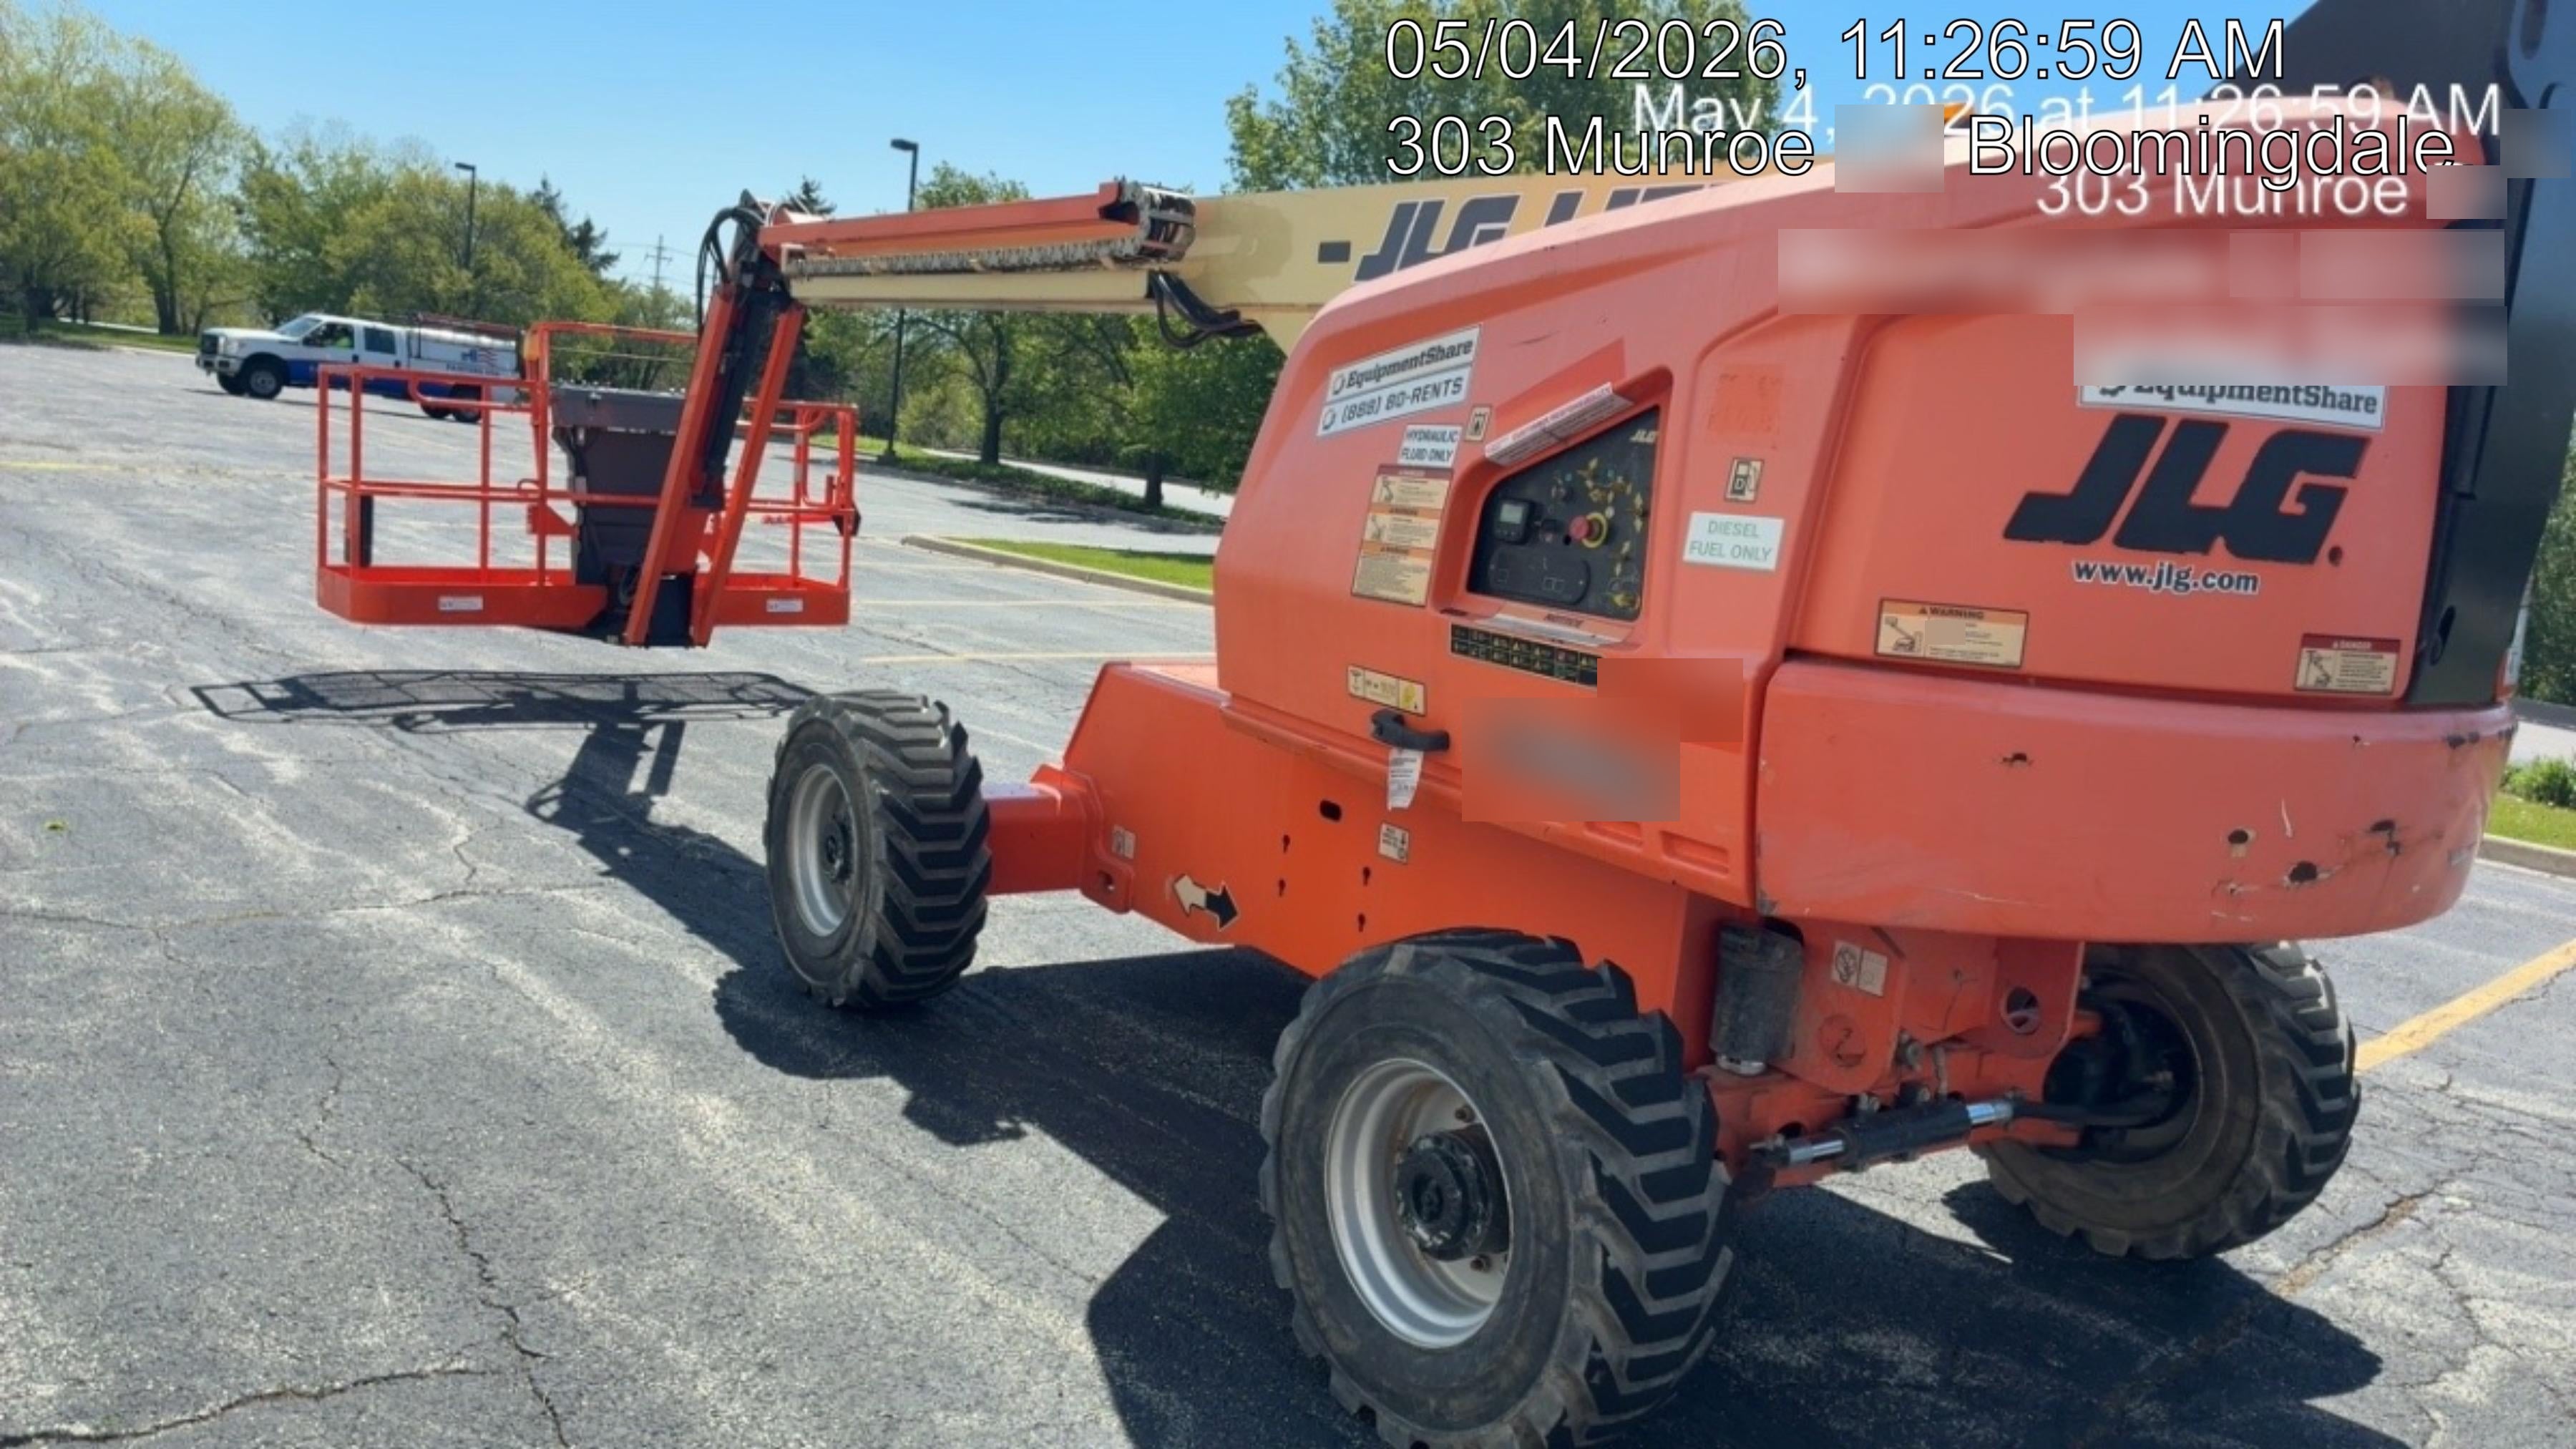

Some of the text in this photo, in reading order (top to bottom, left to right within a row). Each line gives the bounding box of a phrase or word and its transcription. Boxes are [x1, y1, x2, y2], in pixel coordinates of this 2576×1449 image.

[1347, 340, 1473, 389] EquipmentShare
[1341, 394, 1382, 424] (888)
[2002, 411, 2372, 565] JLG
[1707, 519, 1760, 538] DIESEL
[1689, 540, 1772, 562] FUEL ONLY
[2074, 560, 2259, 594] www.jlg.com
